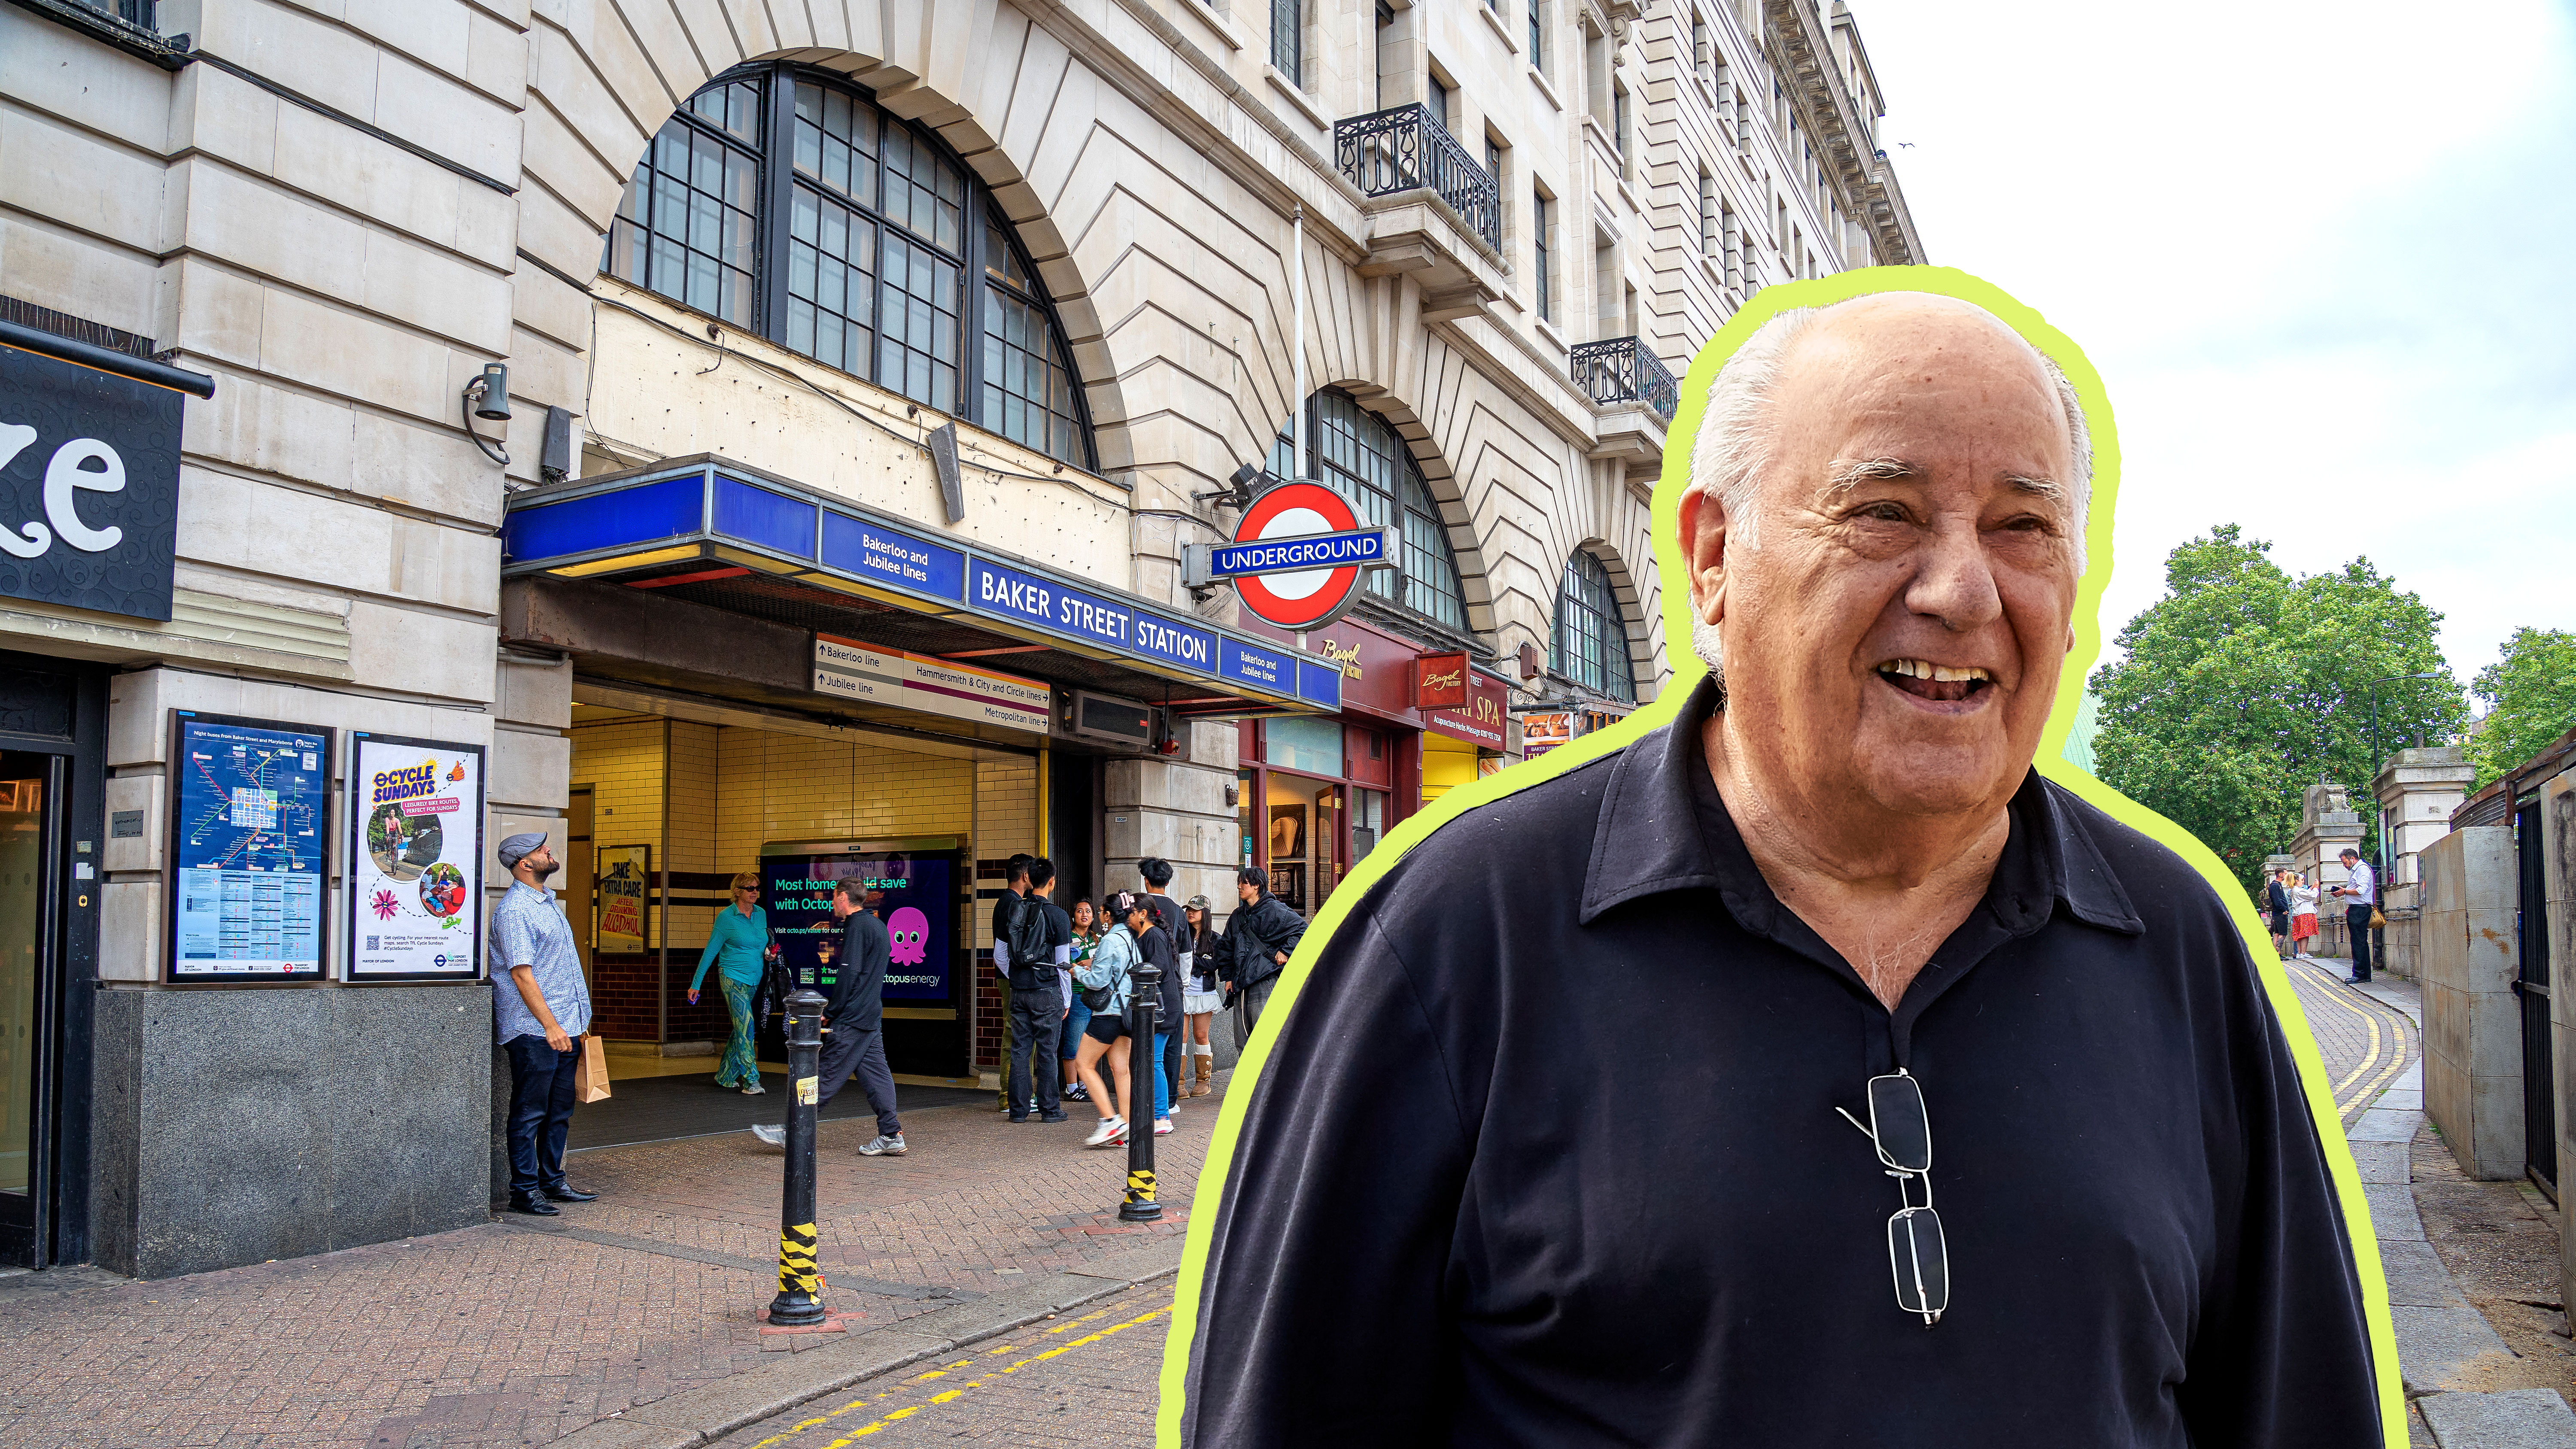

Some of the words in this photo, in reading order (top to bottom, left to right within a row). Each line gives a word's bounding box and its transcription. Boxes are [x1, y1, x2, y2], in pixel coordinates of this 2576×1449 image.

[863, 534, 907, 559] Bakerloo
[910, 551, 928, 566] and
[1222, 538, 1376, 569] UNDERGROUND
[863, 553, 900, 574] Jubilee
[904, 561, 927, 582] lines
[981, 571, 1051, 618] BAKER
[1060, 596, 1129, 640] STREET
[1138, 621, 1206, 663] STATION
[827, 646, 863, 664] Bakerloo
[865, 654, 880, 668] line
[1241, 651, 1265, 668] Bakerloo
[1266, 659, 1276, 671] and
[1322, 639, 1362, 678] Bagel
[1241, 664, 1261, 679] Jubilee
[1262, 670, 1276, 683] lines
[1346, 665, 1362, 680] FACTORY
[1422, 669, 1461, 691] Bagel
[1470, 675, 1482, 687] TREET
[826, 676, 856, 691] Jubilee
[859, 681, 873, 694] line
[916, 666, 967, 686] Hammersmith
[969, 677, 975, 687] &
[976, 679, 990, 692] City
[992, 683, 1005, 693] and
[1006, 685, 1025, 699] Circle
[1027, 689, 1042, 701] lines
[985, 707, 1027, 723] Metropolitan
[1028, 714, 1040, 726] line
[1477, 696, 1501, 727] SPA
[1588, 711, 1626, 732] TH
[1434, 715, 1455, 729] Acupuncture
[1456, 721, 1466, 732] Herbs
[1466, 724, 1480, 737] Massage
[388, 765, 434, 784] CYCLE
[374, 781, 435, 802] SUNDAYS
[612, 862, 630, 879] TAKE
[604, 879, 622, 895] EXTRA
[623, 881, 641, 898] CARE
[776, 879, 802, 890] Most
[806, 878, 838, 890] home
[880, 878, 906, 888] save
[609, 905, 637, 916] DRINKING
[617, 897, 633, 906] AFTER
[775, 899, 799, 910] with
[802, 898, 834, 911] Octop
[601, 913, 641, 936] ALCOHOL
